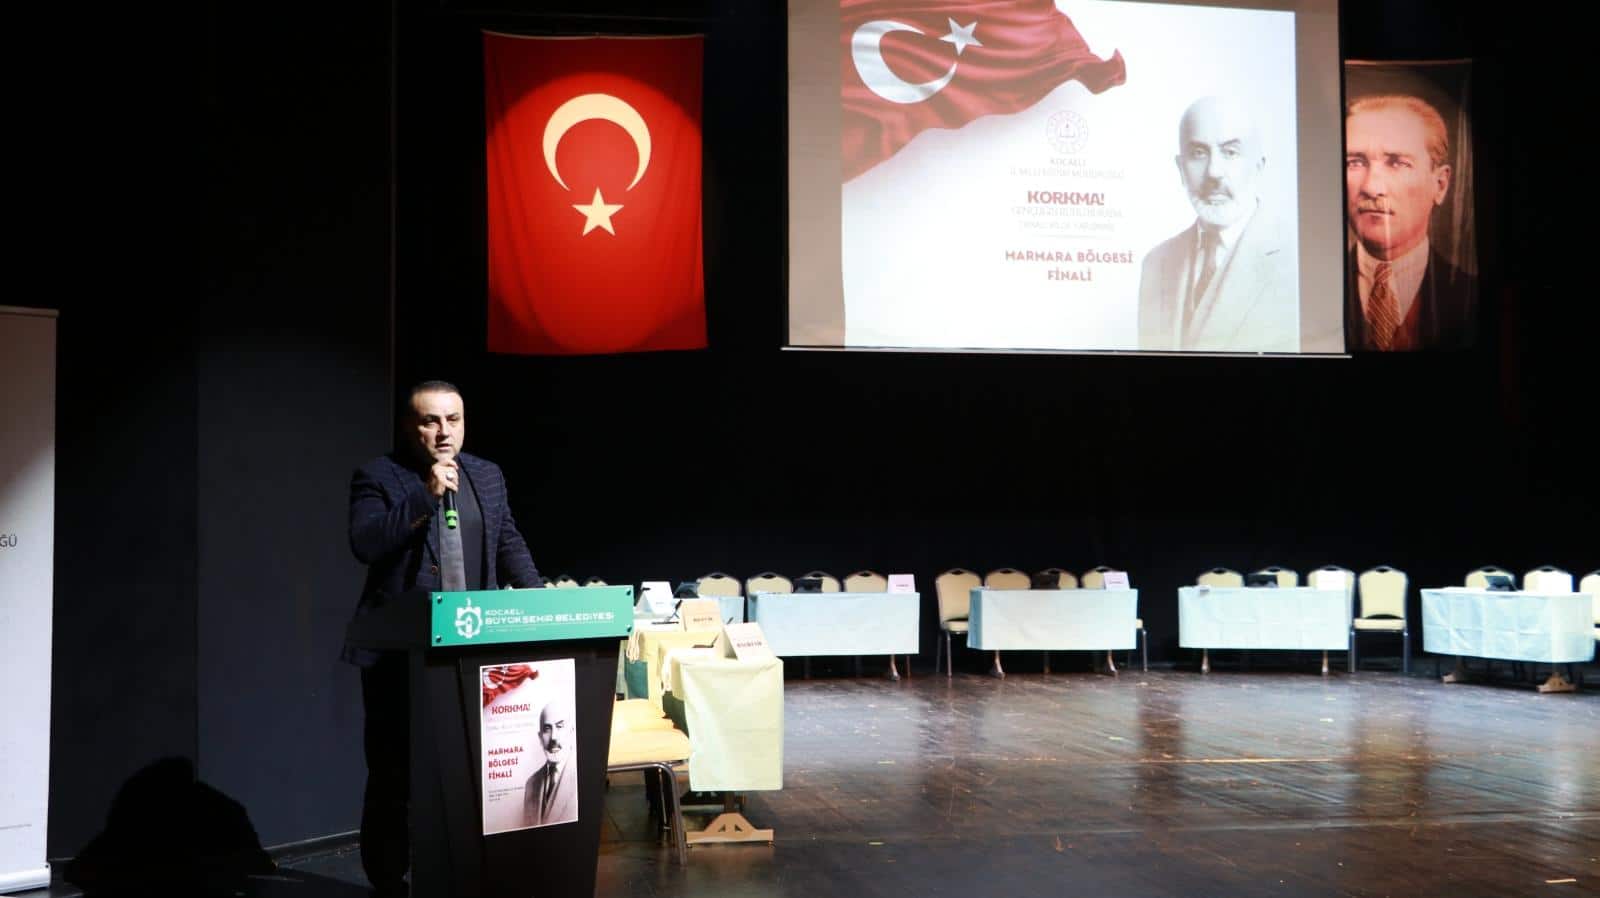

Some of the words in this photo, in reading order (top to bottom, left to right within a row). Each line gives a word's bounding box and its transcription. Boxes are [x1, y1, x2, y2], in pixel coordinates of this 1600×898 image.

[1027, 190, 1105, 206] KORKMA!
[1005, 249, 1073, 262] MARMARA
[1077, 249, 1134, 264] BÖLGESİ
[1047, 267, 1092, 282] FİNALİ
[491, 703, 531, 715] KORKMA!
[488, 745, 524, 756] MARMARA
[488, 756, 519, 768] BÖLGESİ
[488, 768, 513, 780] FİNALİ
